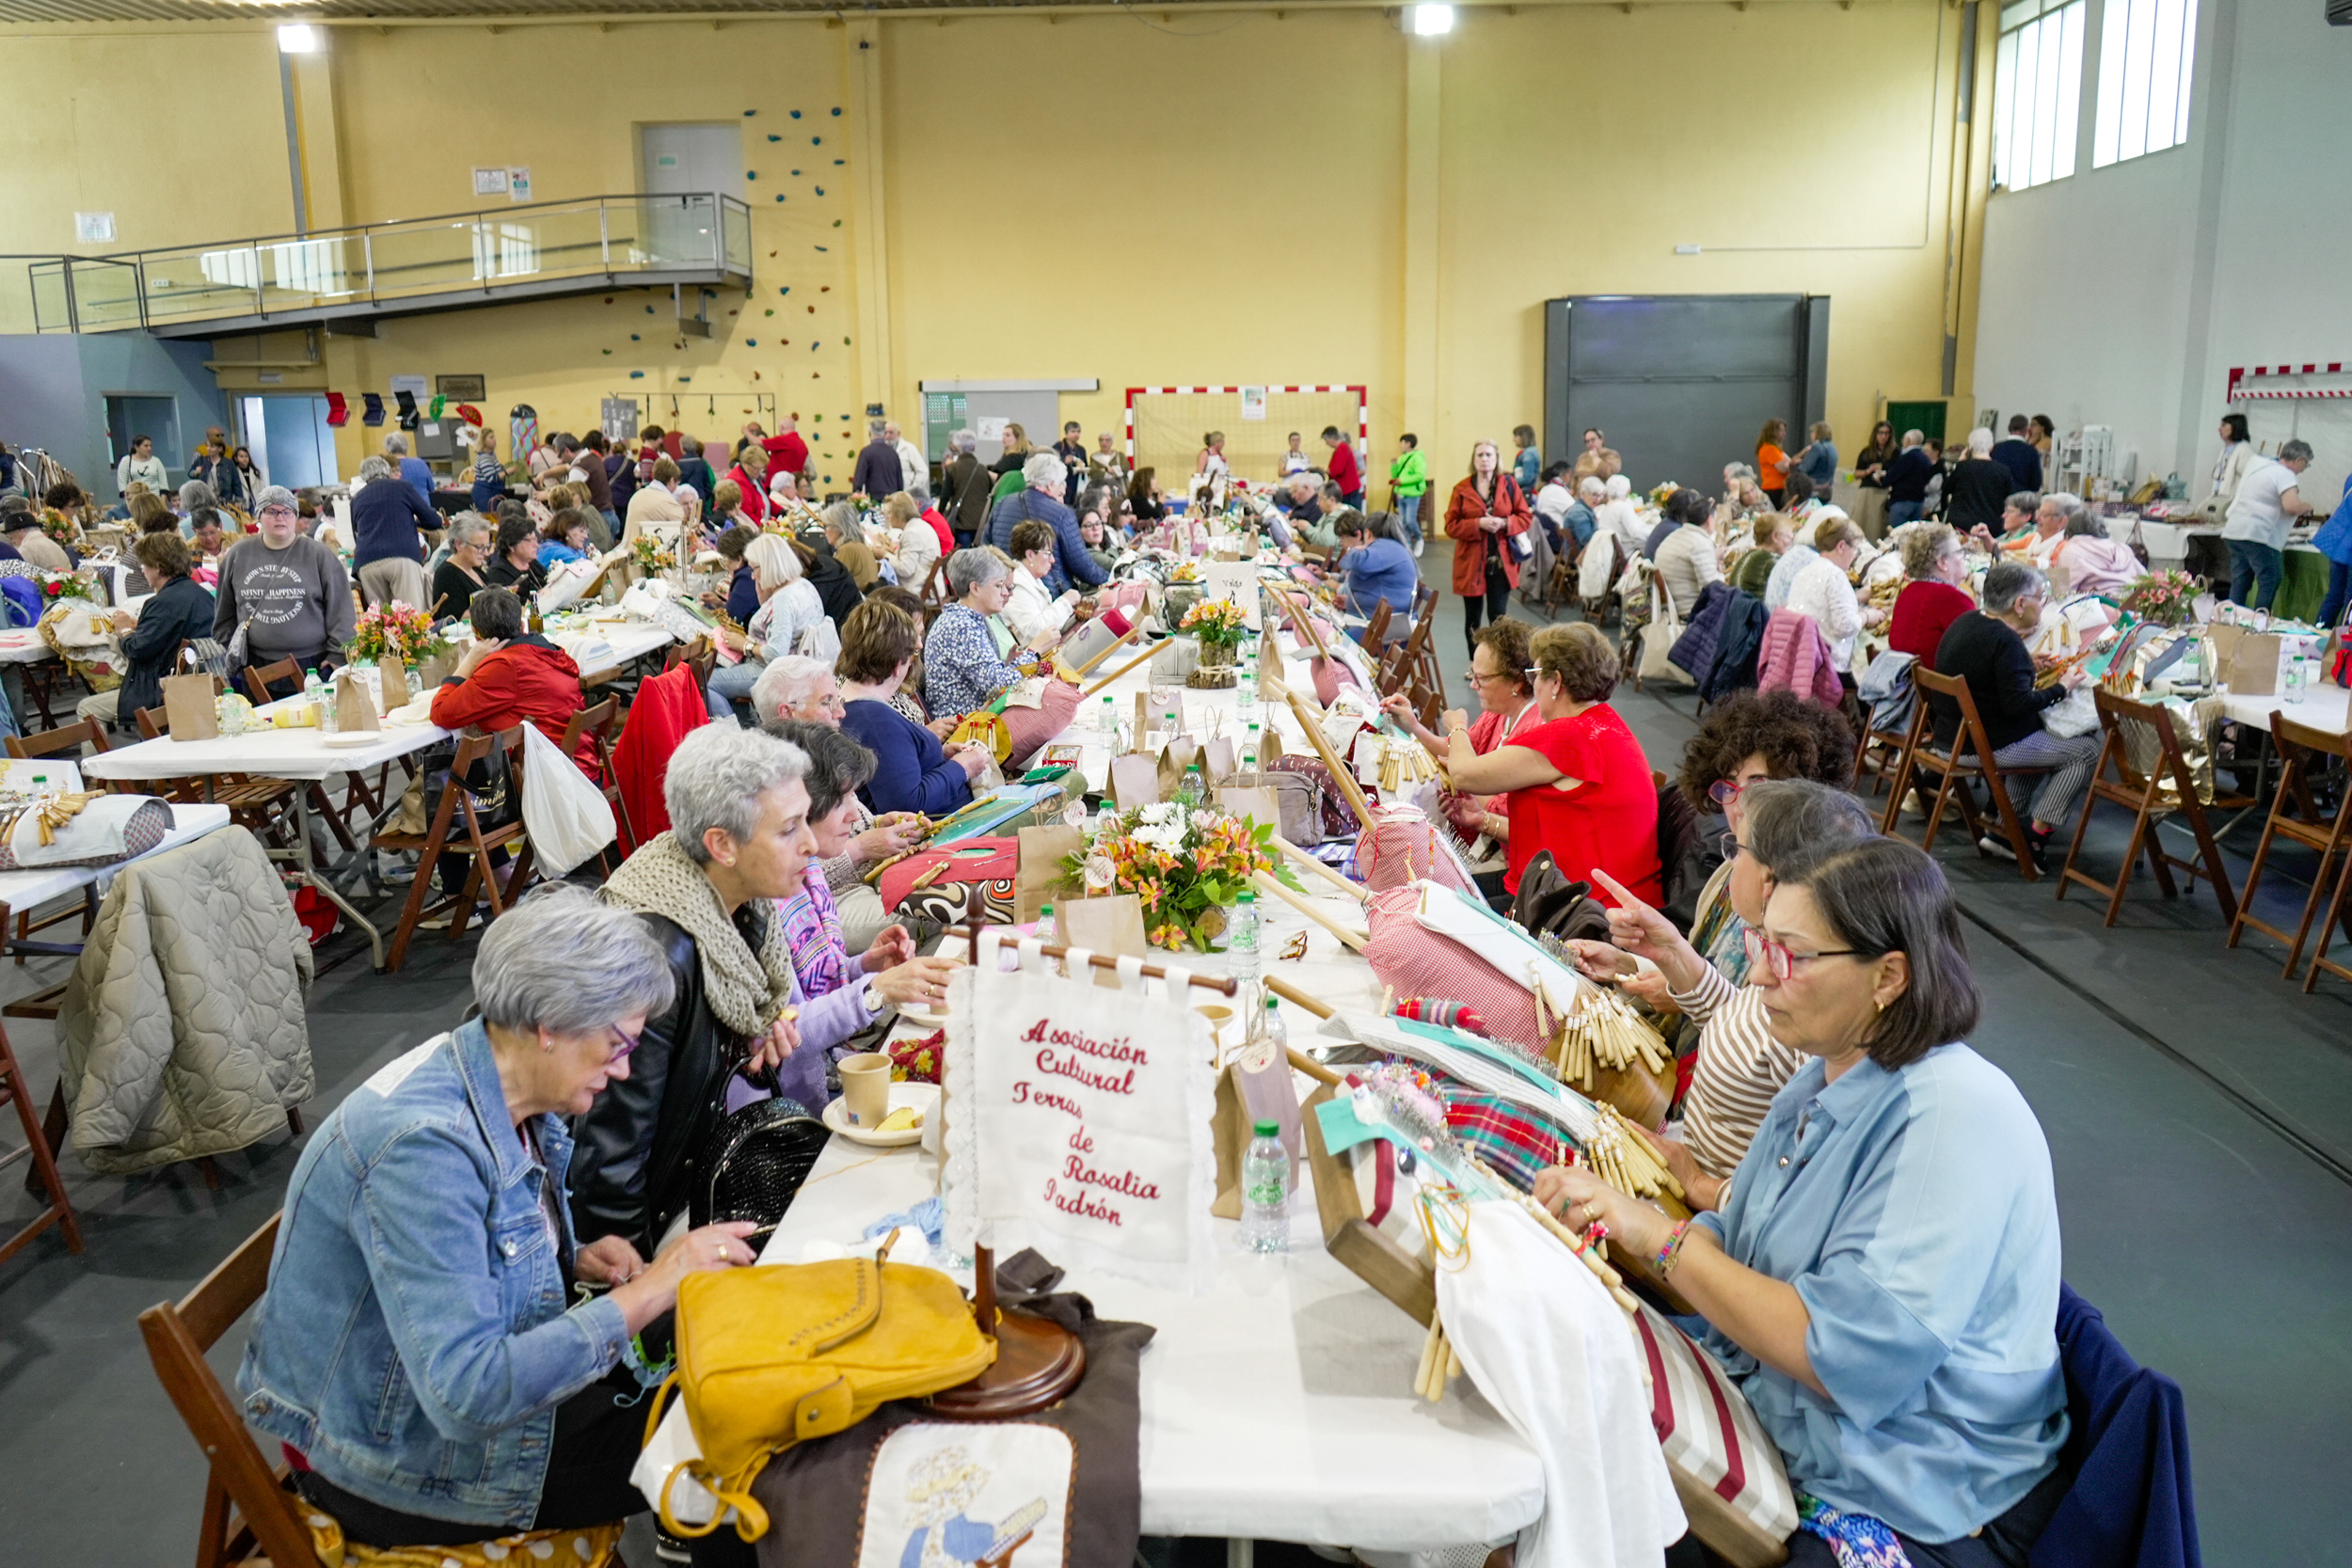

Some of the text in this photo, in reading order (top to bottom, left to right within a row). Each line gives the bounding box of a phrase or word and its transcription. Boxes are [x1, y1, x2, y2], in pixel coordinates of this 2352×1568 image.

[244, 566, 264, 585] GROWN
[288, 569, 302, 583] STEP
[269, 588, 306, 596] HAPPINESS
[270, 613, 290, 624] LONG
[287, 600, 304, 619] SINCE
[1020, 1019, 1149, 1065] Asociación
[1036, 1049, 1136, 1095] Cultural
[1012, 1082, 1084, 1119] Terras
[1069, 1125, 1094, 1153] de
[1043, 1178, 1121, 1227] Padrón
